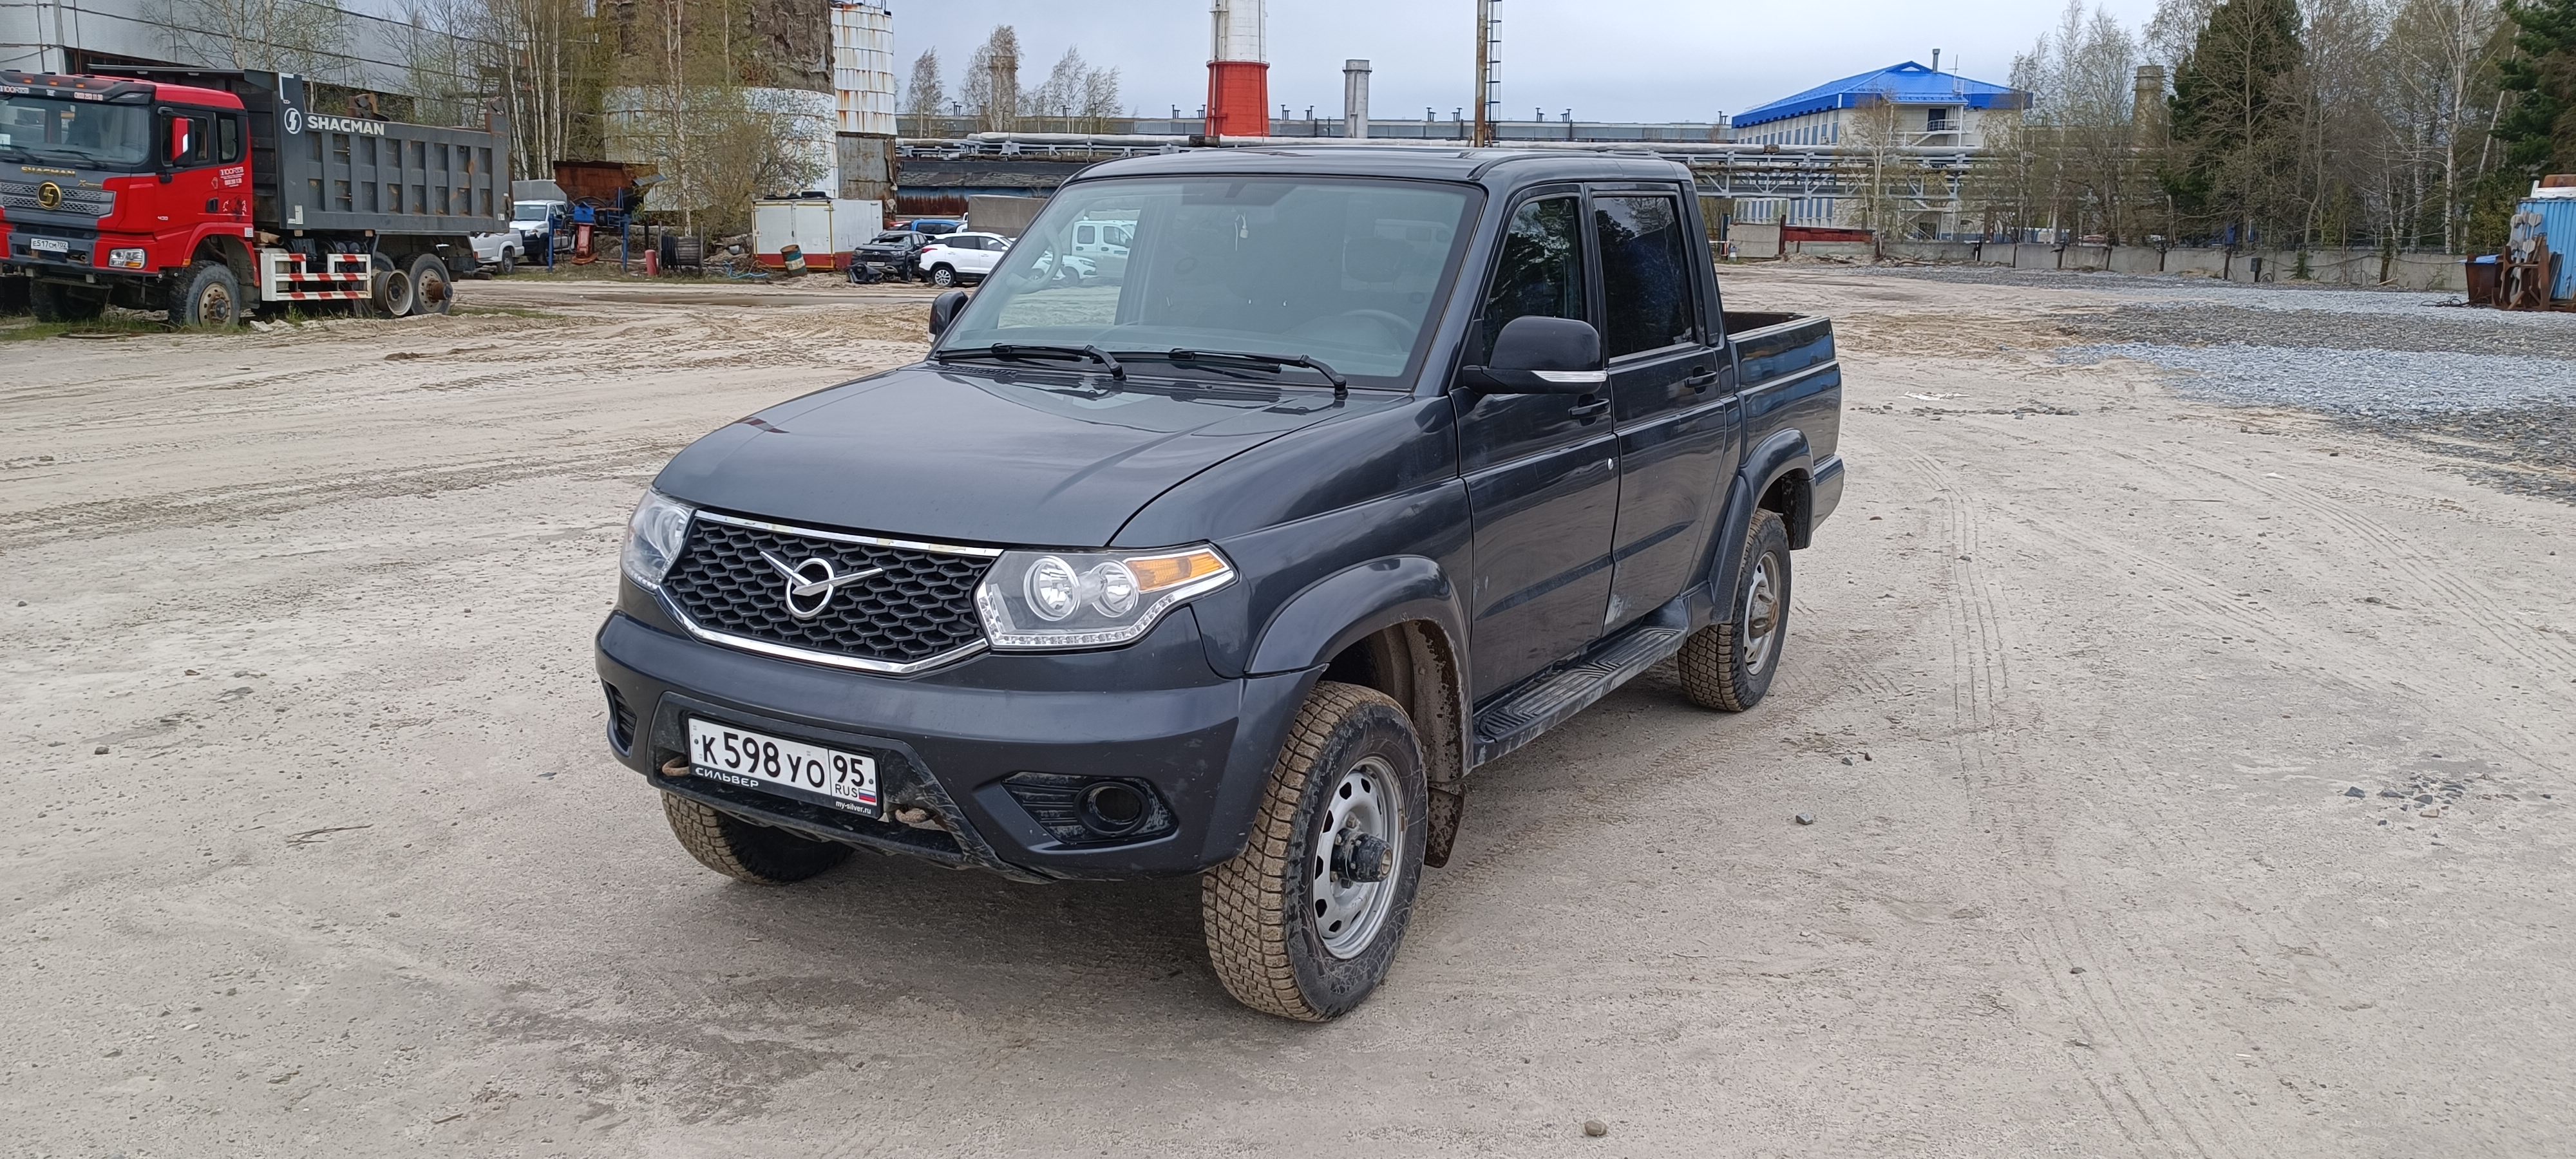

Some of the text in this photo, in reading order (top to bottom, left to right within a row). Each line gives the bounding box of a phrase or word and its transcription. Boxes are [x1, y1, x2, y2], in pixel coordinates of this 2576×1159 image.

[307, 115, 384, 135] SHACMAN
[696, 767, 759, 787] СИЛЬВЕР
[833, 755, 864, 787] 95
[835, 784, 858, 798] RUS
[835, 801, 871, 815] my-silver.ru
